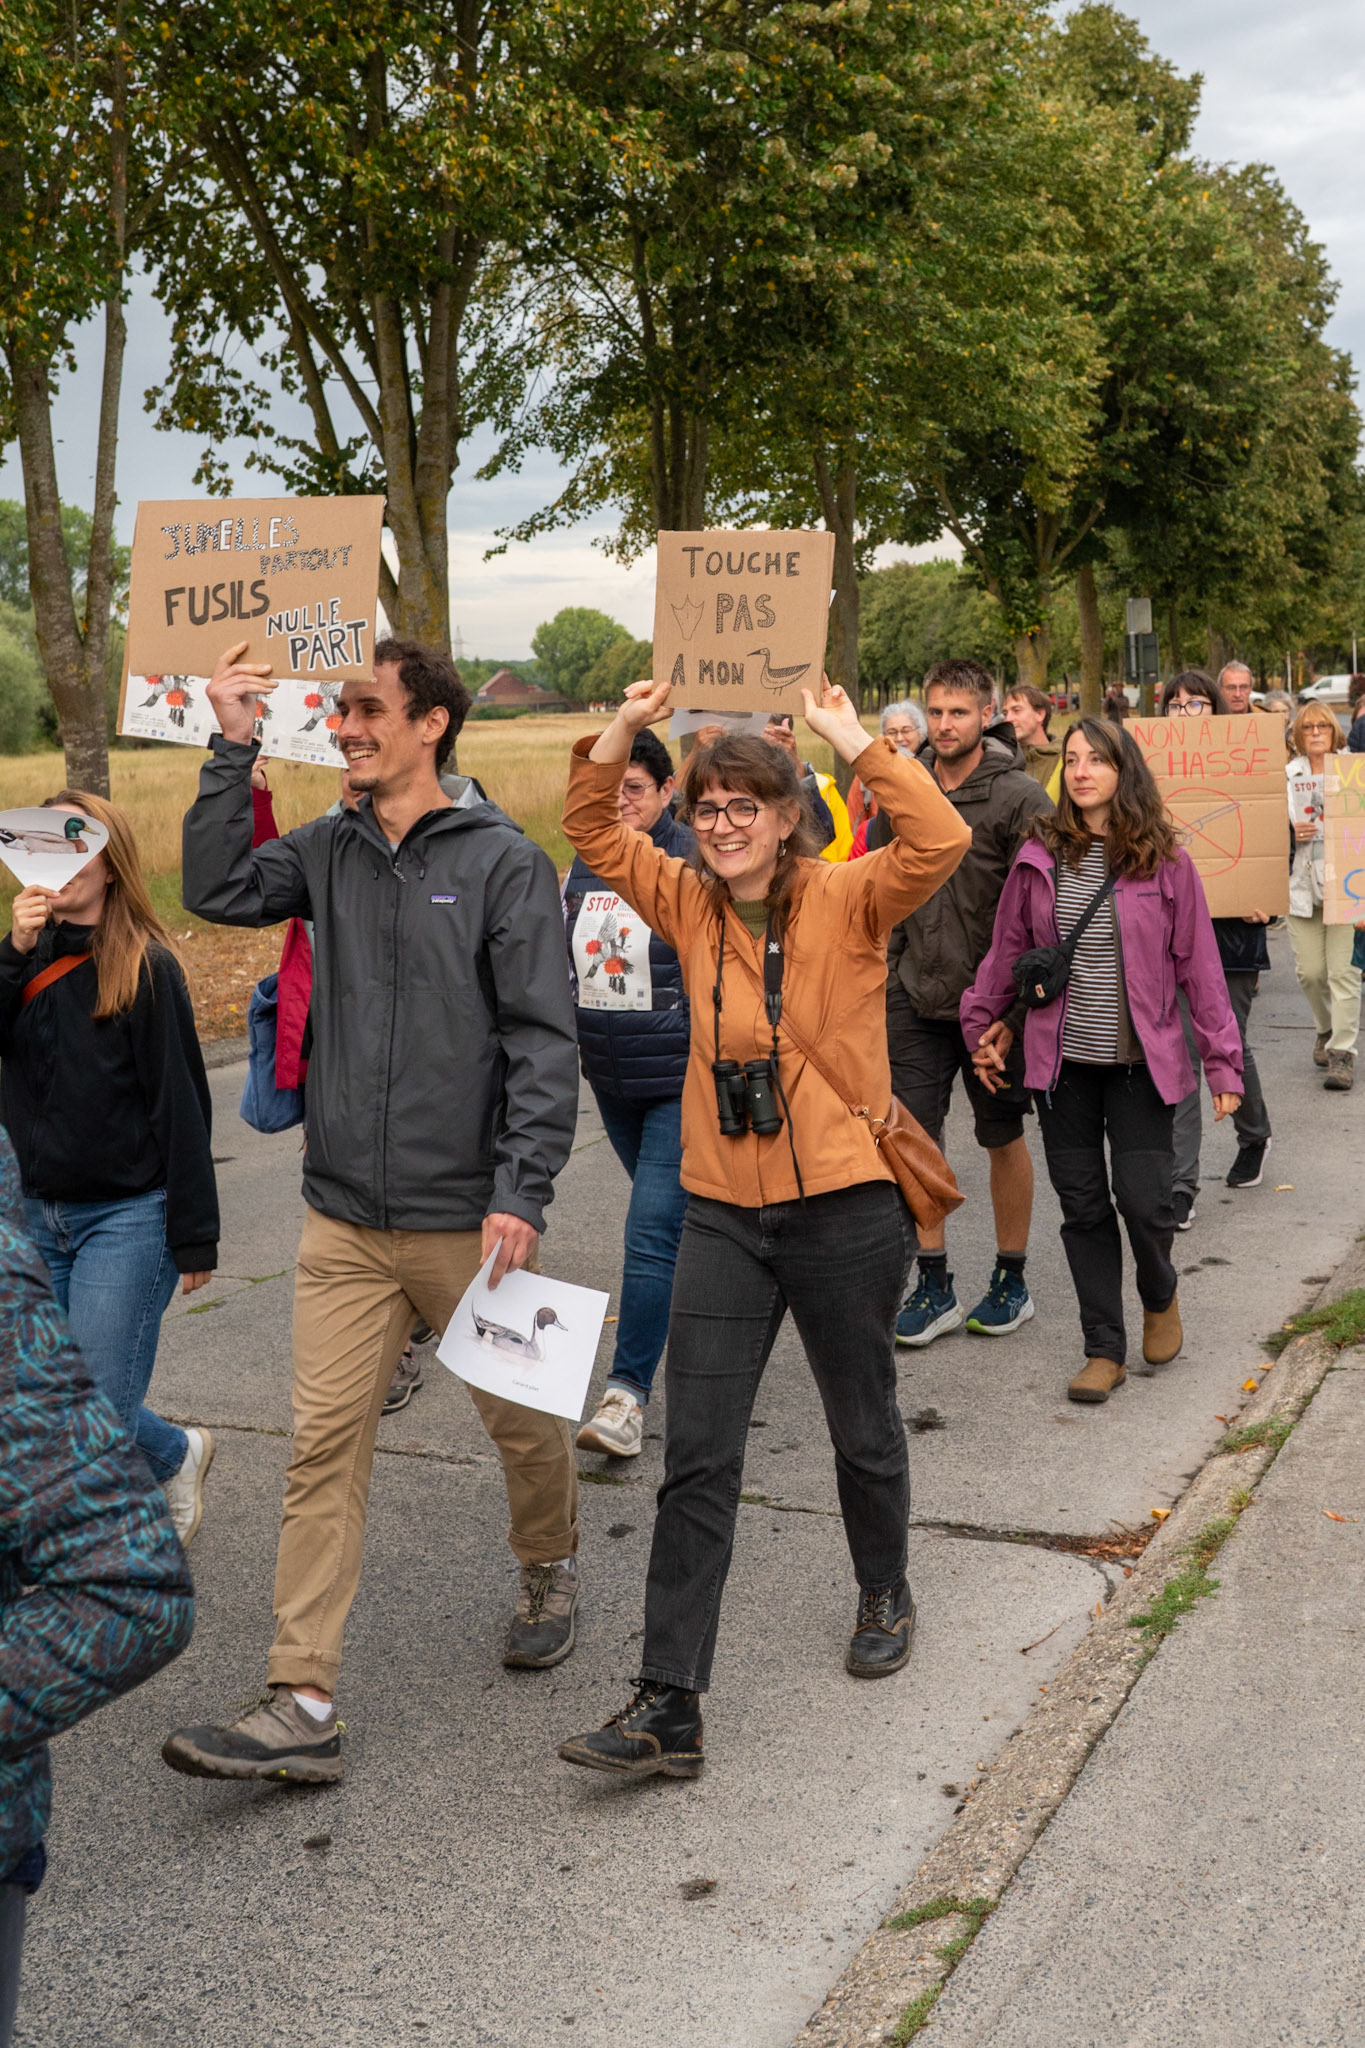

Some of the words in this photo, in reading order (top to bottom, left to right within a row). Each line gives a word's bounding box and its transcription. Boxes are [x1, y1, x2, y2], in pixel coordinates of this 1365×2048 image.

[161, 516, 299, 559] JUMELLES
[260, 545, 352, 575] PARTOUT
[682, 547, 800, 577] TOUCHE
[164, 579, 270, 626] FUSILS
[266, 597, 341, 638] NULLE
[716, 593, 776, 633] PAS
[289, 618, 367, 672] PART
[670, 653, 685, 686] A
[699, 659, 744, 685] MON
[1134, 720, 1185, 749] NON
[1226, 718, 1260, 745] LA
[1294, 781, 1317, 792] STOP
[587, 897, 619, 911] STOP
